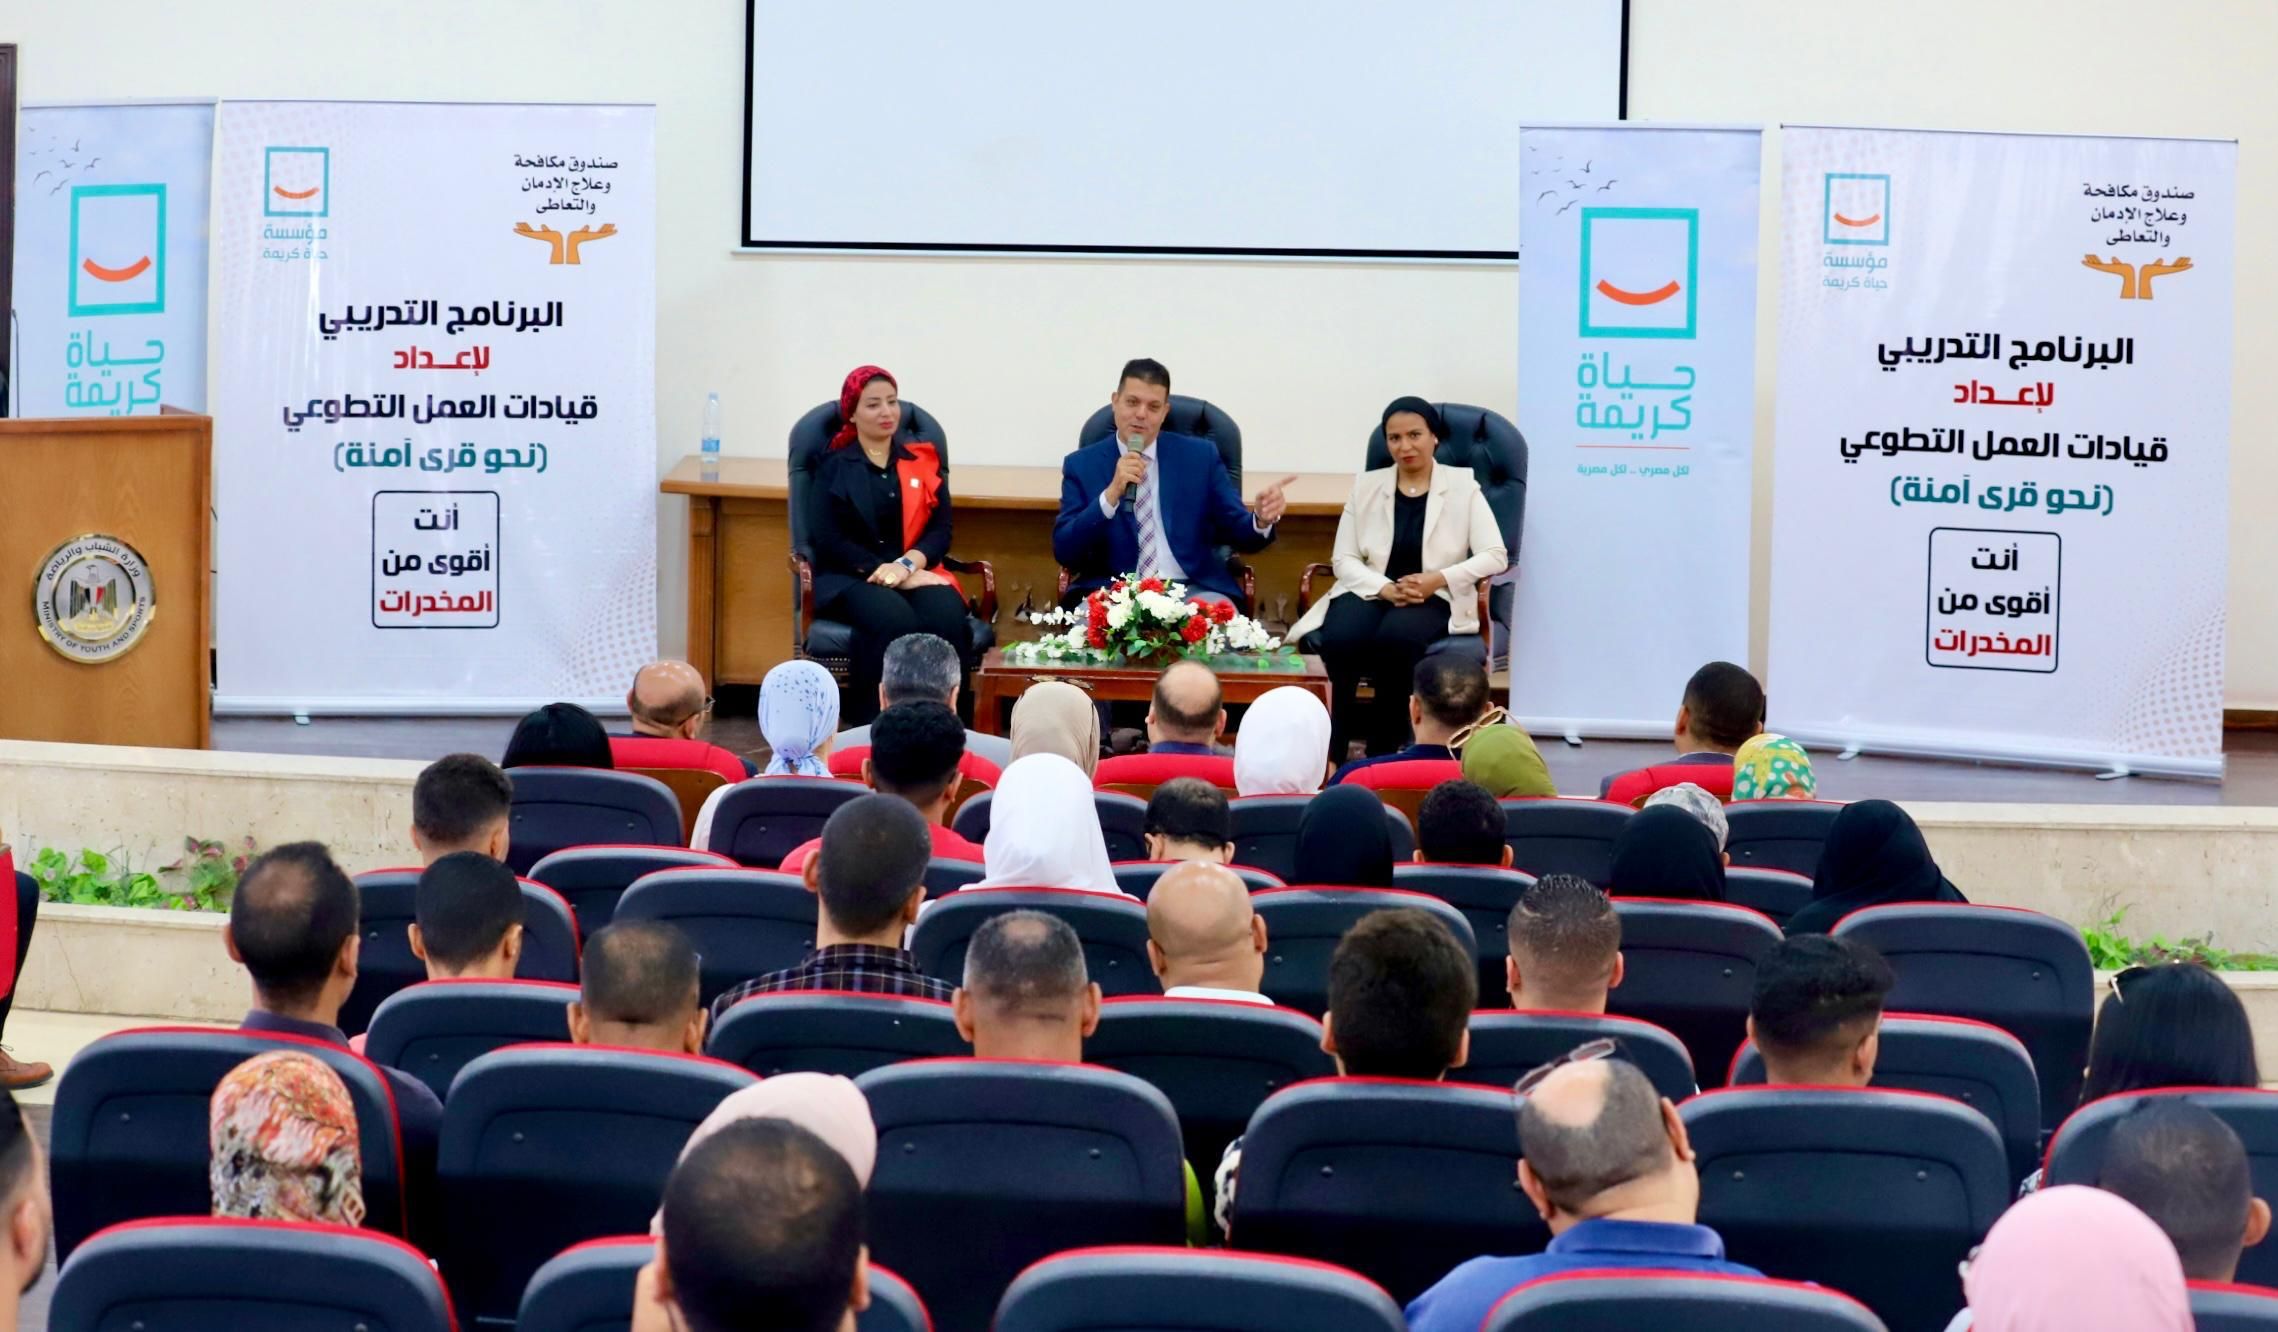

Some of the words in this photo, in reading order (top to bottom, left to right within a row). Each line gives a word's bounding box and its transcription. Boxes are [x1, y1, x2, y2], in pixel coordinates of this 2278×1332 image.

[514, 154, 565, 168] مكافحة
[568, 156, 618, 172] صندوق
[521, 177, 568, 193] الإدمان
[571, 177, 611, 195] وعلاج
[2083, 183, 2138, 198] مكافحة
[2141, 186, 2195, 203] صندوق
[2091, 207, 2142, 224] الإدمان
[2144, 208, 2187, 227] وعلاج
[264, 223, 327, 245] مؤسسة
[262, 247, 300, 263] كريمة
[1823, 252, 1888, 274] مؤسسة
[1822, 276, 1860, 291] كريمة
[1863, 277, 1888, 291] حياة
[319, 300, 438, 340] التدريبي
[446, 301, 563, 335] البرنامج
[66, 329, 165, 377] حياة
[393, 345, 490, 376] لإعداد
[1878, 332, 2001, 372] التدريبي
[2009, 336, 2134, 370] البرنامج
[1577, 351, 1696, 400] حياة
[65, 368, 161, 416] كريمة
[1953, 379, 2054, 413] لإعداد
[283, 394, 405, 432] التطوعي
[413, 394, 496, 424] العمل
[503, 395, 598, 425] قيادات
[1576, 393, 1691, 440] كريمة
[419, 442, 476, 473] قرى
[483, 443, 548, 473] (نحو
[1840, 427, 1965, 464] التطوعي
[1972, 430, 2060, 461] العمل
[2067, 434, 2169, 467] قيادات
[1577, 464, 1608, 476] مصرية
[1610, 464, 1627, 476] لكل
[1639, 465, 1670, 477] مصري
[1672, 465, 1690, 478] لكل
[1977, 482, 2038, 512] قرى
[2046, 484, 2113, 516] (نحو
[414, 502, 458, 530] أنت
[85, 542, 120, 555] الشباب
[382, 549, 422, 577] من
[428, 543, 490, 576] أقوى
[1971, 542, 2018, 571] أنت
[47, 546, 82, 581] والرياضة
[120, 553, 141, 578] وزارة
[379, 590, 493, 617] المخدرات
[1938, 587, 1978, 615] من
[1985, 585, 2050, 618] أقوى
[42, 600, 67, 642] MINISTRY
[66, 639, 79, 649] OF
[80, 643, 110, 653] YOUTH
[112, 632, 129, 647] AND
[129, 596, 146, 633] SPORTS
[1934, 629, 2051, 657] المخدرات
